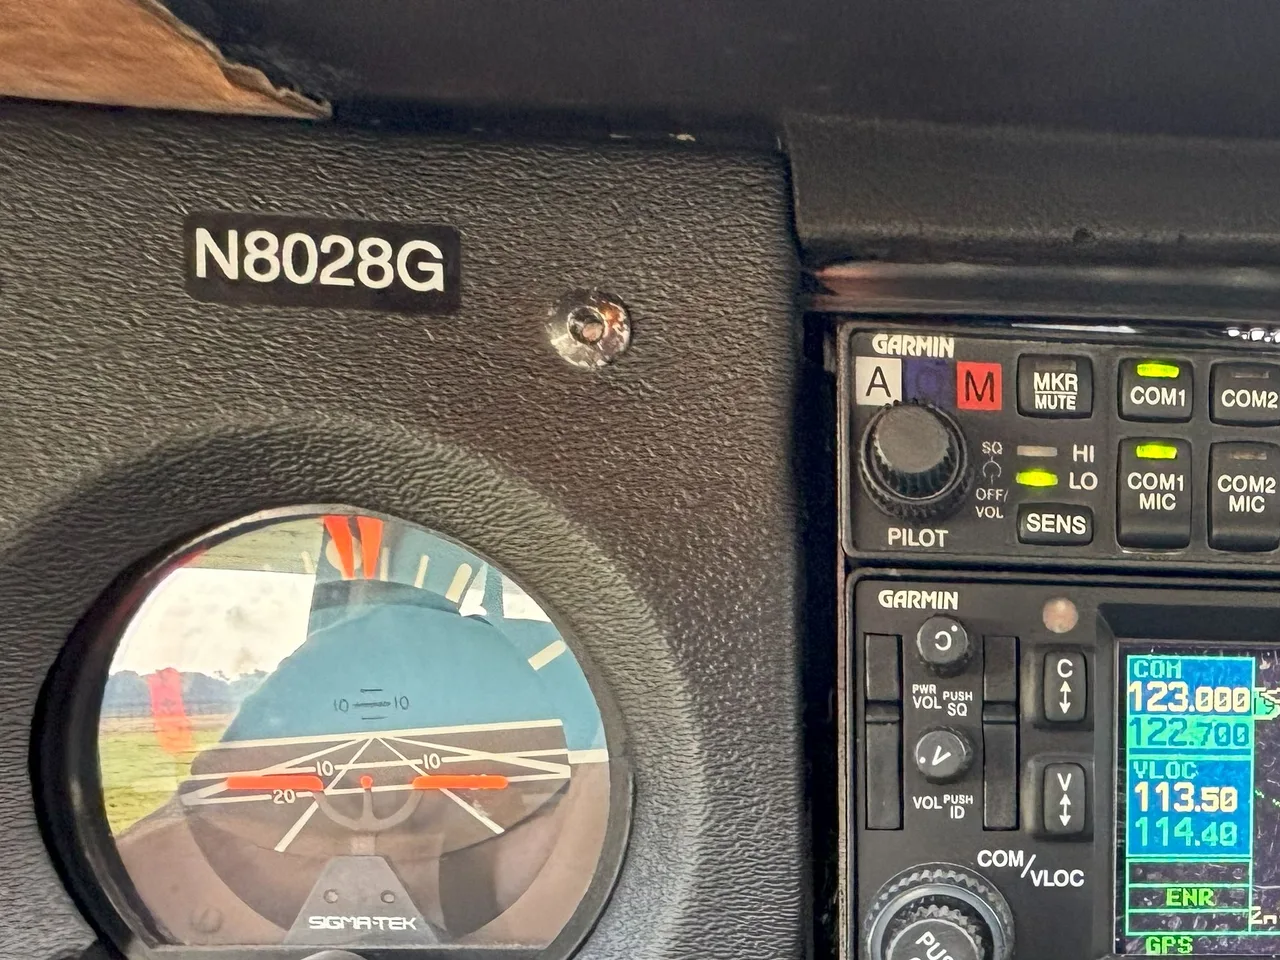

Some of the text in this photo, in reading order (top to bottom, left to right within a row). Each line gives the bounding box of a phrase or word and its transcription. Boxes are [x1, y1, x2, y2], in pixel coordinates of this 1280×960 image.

[195, 226, 445, 292] N8028G
[872, 333, 954, 358] GARMIN
[1034, 372, 1078, 391] MKR
[1035, 395, 1076, 410] MUTE
[1130, 386, 1186, 407] COM1
[1221, 389, 1279, 409] COM2
[1073, 444, 1095, 463] HI
[1069, 471, 1098, 490] LO
[1127, 472, 1184, 492] COM1
[1217, 474, 1276, 494] COM2
[1139, 493, 1176, 511] MIC
[1229, 495, 1265, 513] MIC
[976, 506, 1004, 519] VOL
[1027, 513, 1086, 534] SENS
[888, 528, 948, 547] PILOT
[878, 590, 958, 610] GARMIN
[1133, 660, 1182, 679] COM
[912, 684, 937, 695] PWR
[943, 691, 973, 702] PUSH
[1128, 681, 1250, 712] 123.000
[912, 695, 942, 710] VOL
[947, 702, 968, 717] SQ
[1129, 717, 1249, 746] 122.700
[315, 760, 335, 776] 10
[423, 753, 441, 769] 10
[1133, 761, 1197, 779] VLOC
[913, 796, 943, 810] VOL
[944, 794, 973, 805] PUSH
[1135, 781, 1238, 813] 113.50
[950, 805, 965, 819] ID
[1135, 816, 1237, 846] 114.40
[1166, 888, 1215, 906] ENR
[1146, 936, 1193, 954] GPS
